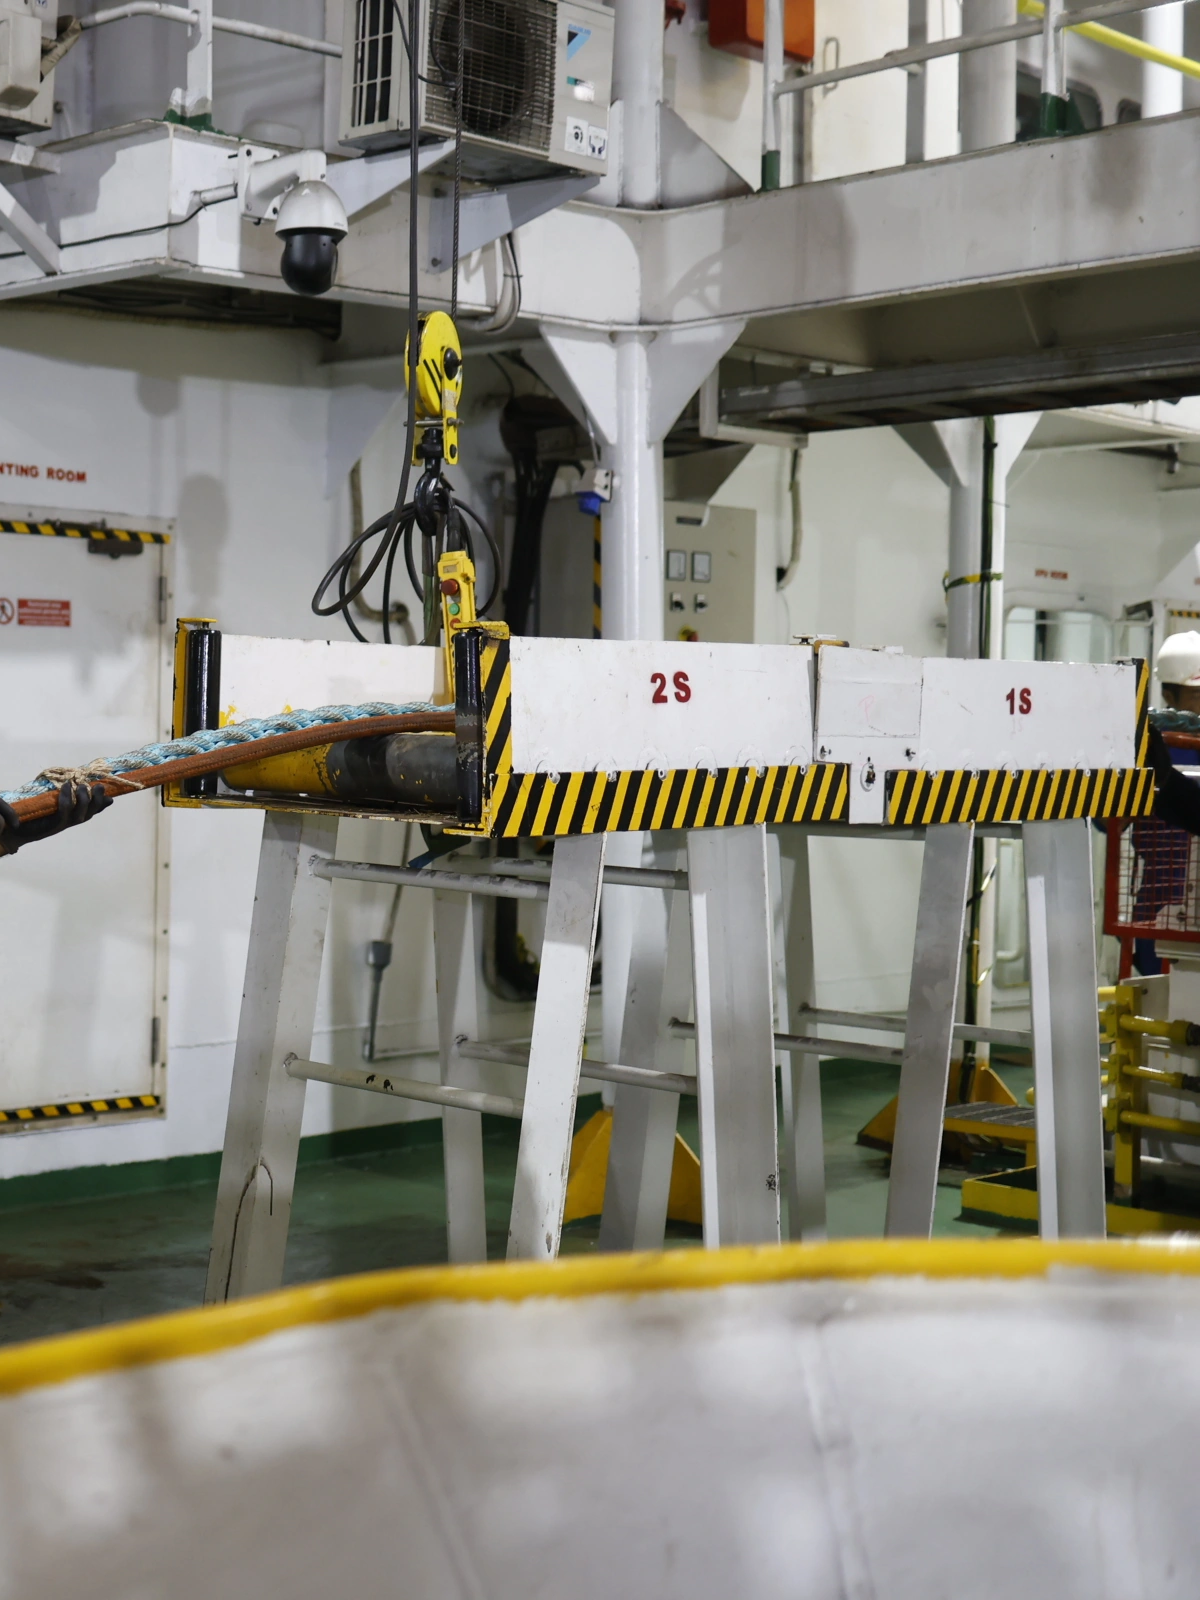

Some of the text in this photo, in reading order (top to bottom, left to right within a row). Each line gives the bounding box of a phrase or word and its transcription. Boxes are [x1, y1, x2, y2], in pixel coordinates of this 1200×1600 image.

[47, 467, 86, 482] ROOM
[650, 671, 692, 704] 2S
[1005, 687, 1032, 715] 1S
